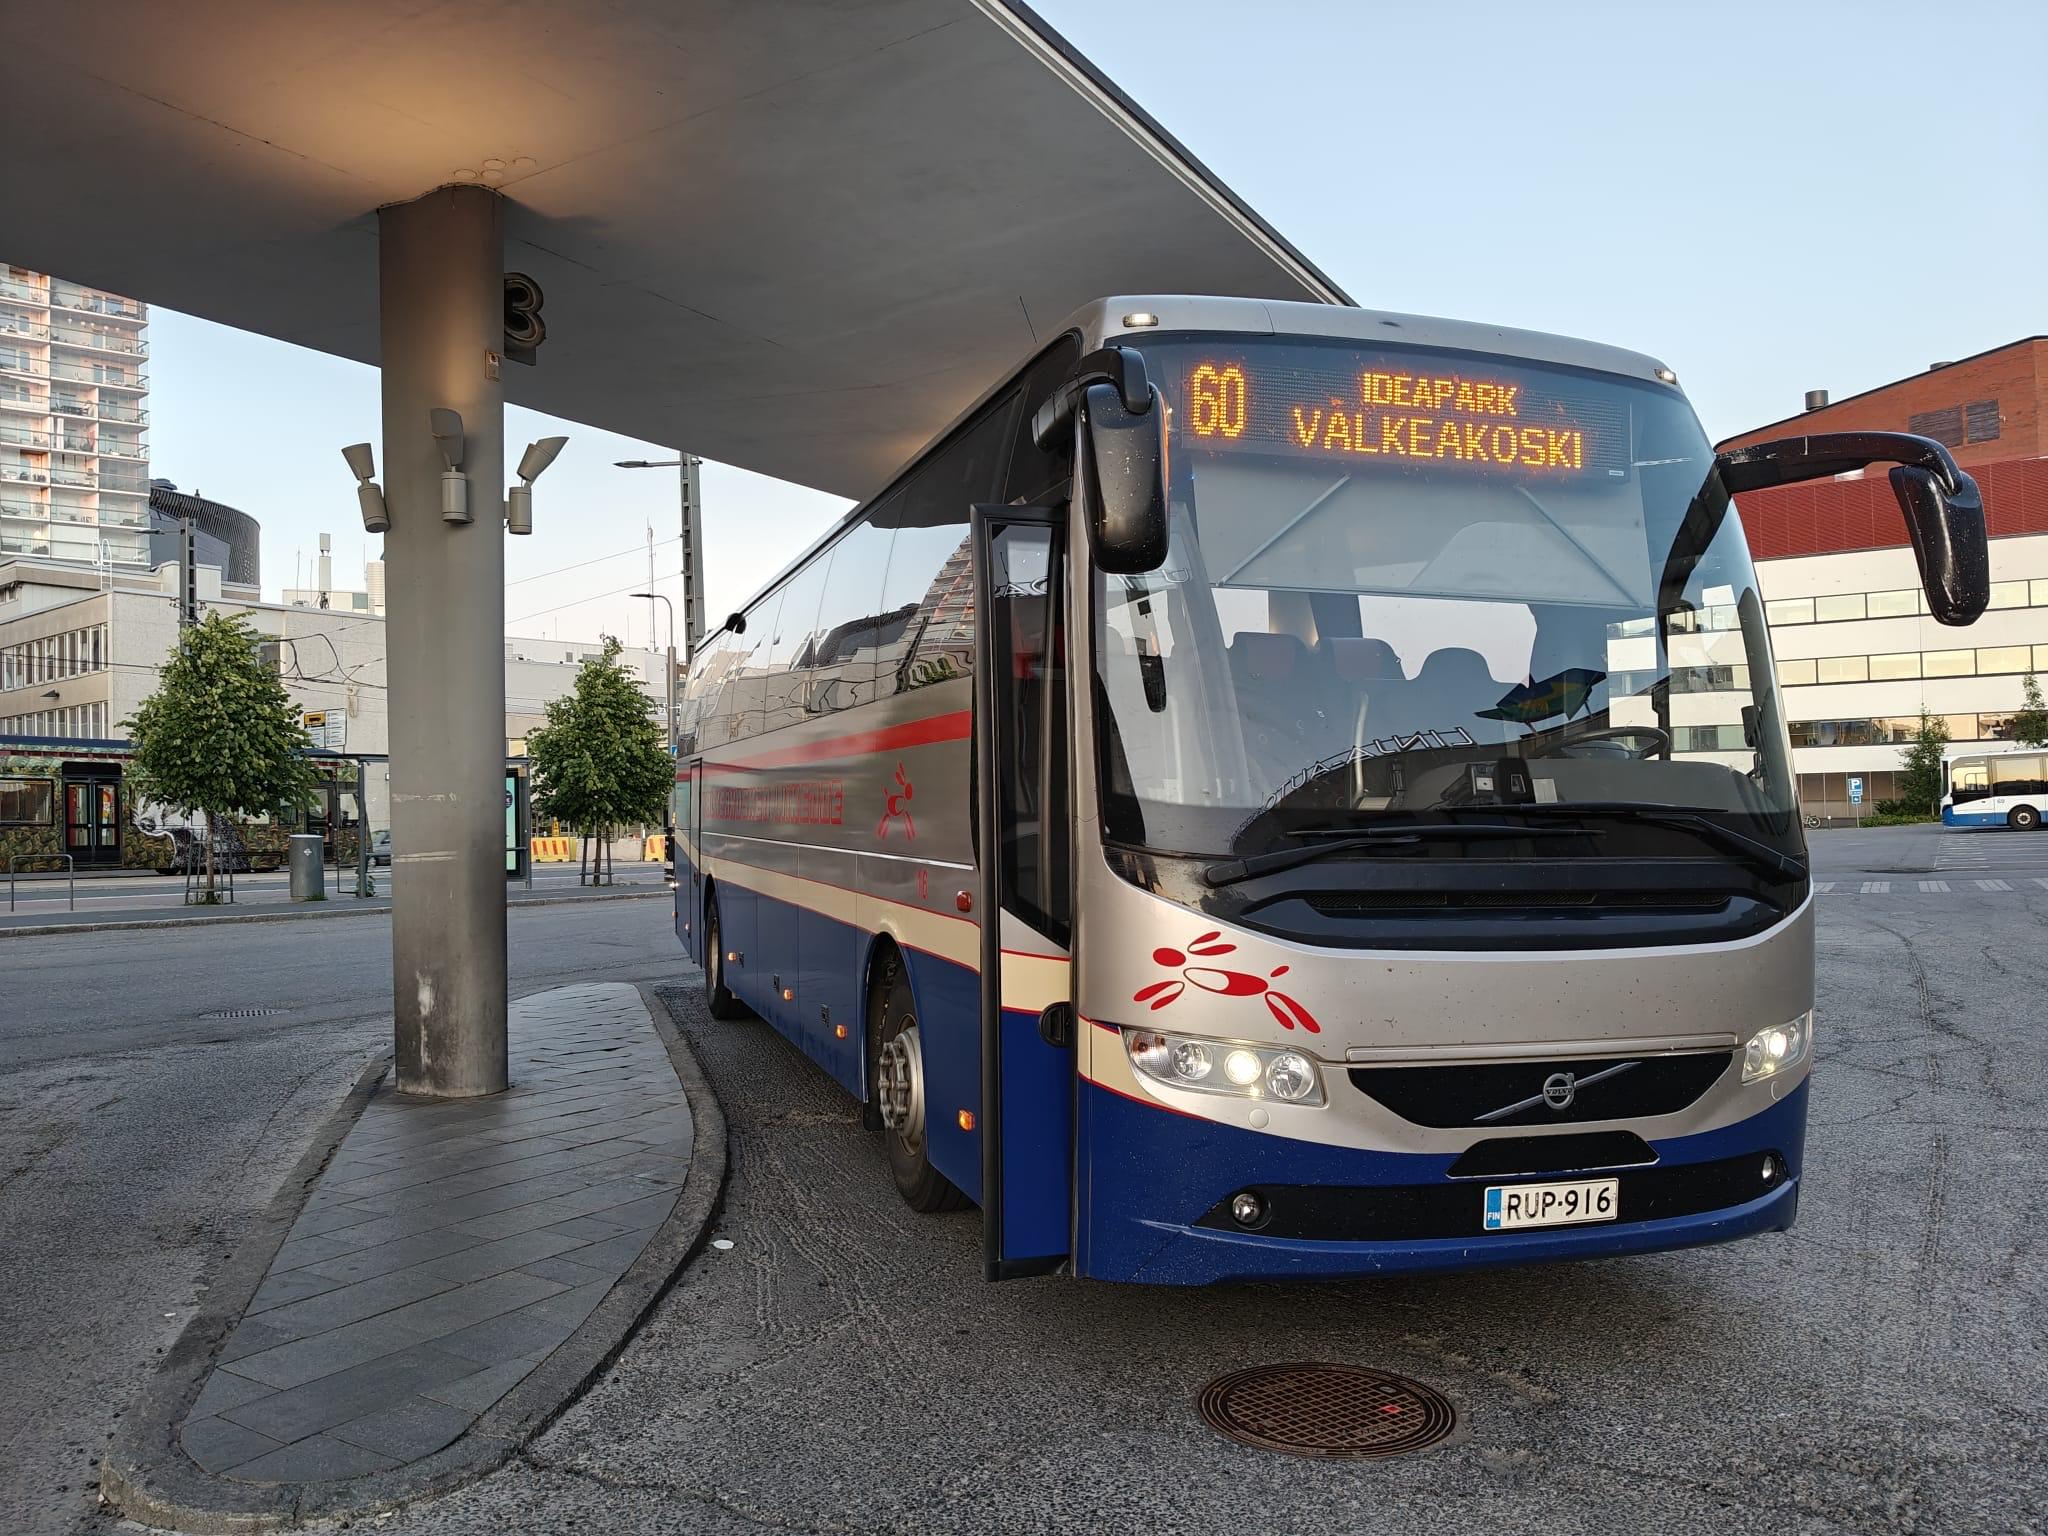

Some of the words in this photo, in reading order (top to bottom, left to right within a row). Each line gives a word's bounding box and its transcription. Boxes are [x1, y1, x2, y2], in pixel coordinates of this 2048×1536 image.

[1193, 365, 1244, 437] 60
[1363, 373, 1517, 416] IDEAPARK
[1294, 408, 1581, 469] VALKEAKOSKI
[1487, 1211, 1500, 1221] FIN
[1507, 1186, 1610, 1220] RUP-916
